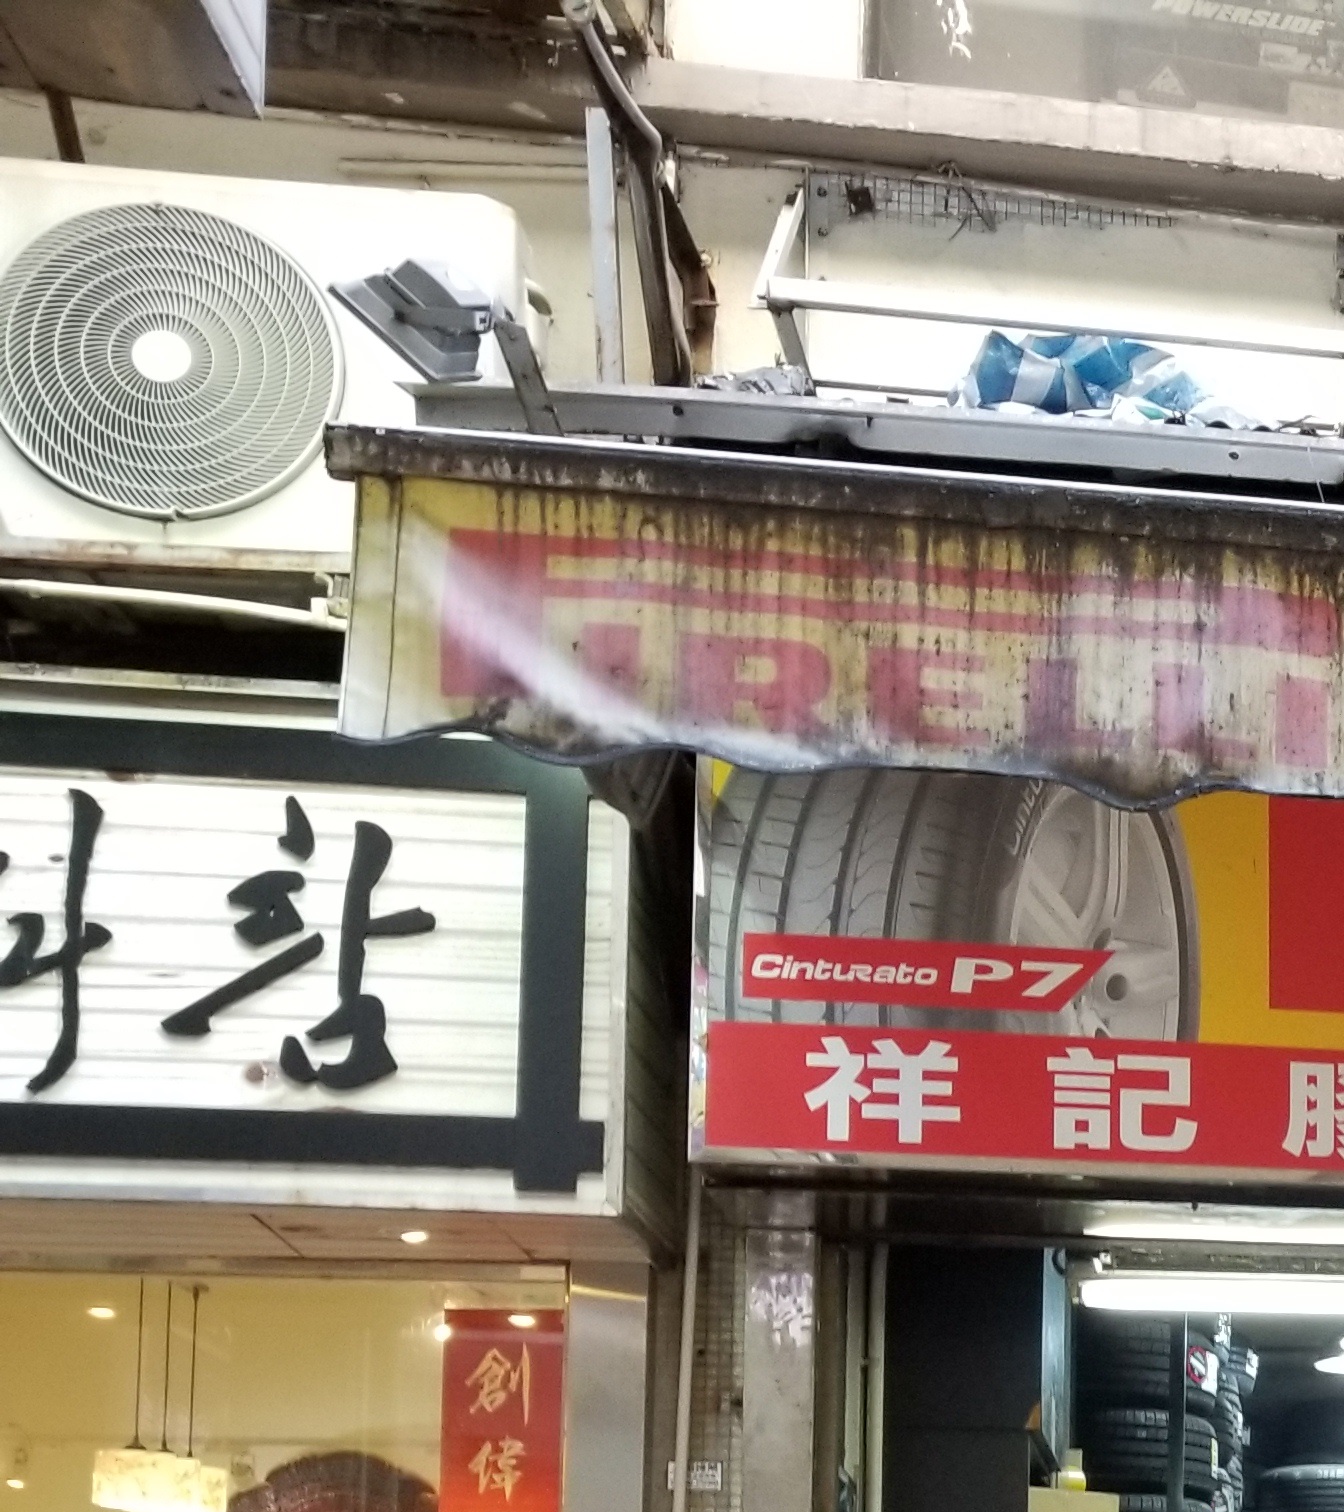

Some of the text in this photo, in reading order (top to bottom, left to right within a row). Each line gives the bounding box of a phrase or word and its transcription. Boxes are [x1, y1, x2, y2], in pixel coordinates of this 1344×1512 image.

[440, 528, 1341, 768] PIRELLI
[751, 953, 1084, 998] Cinturato P7
